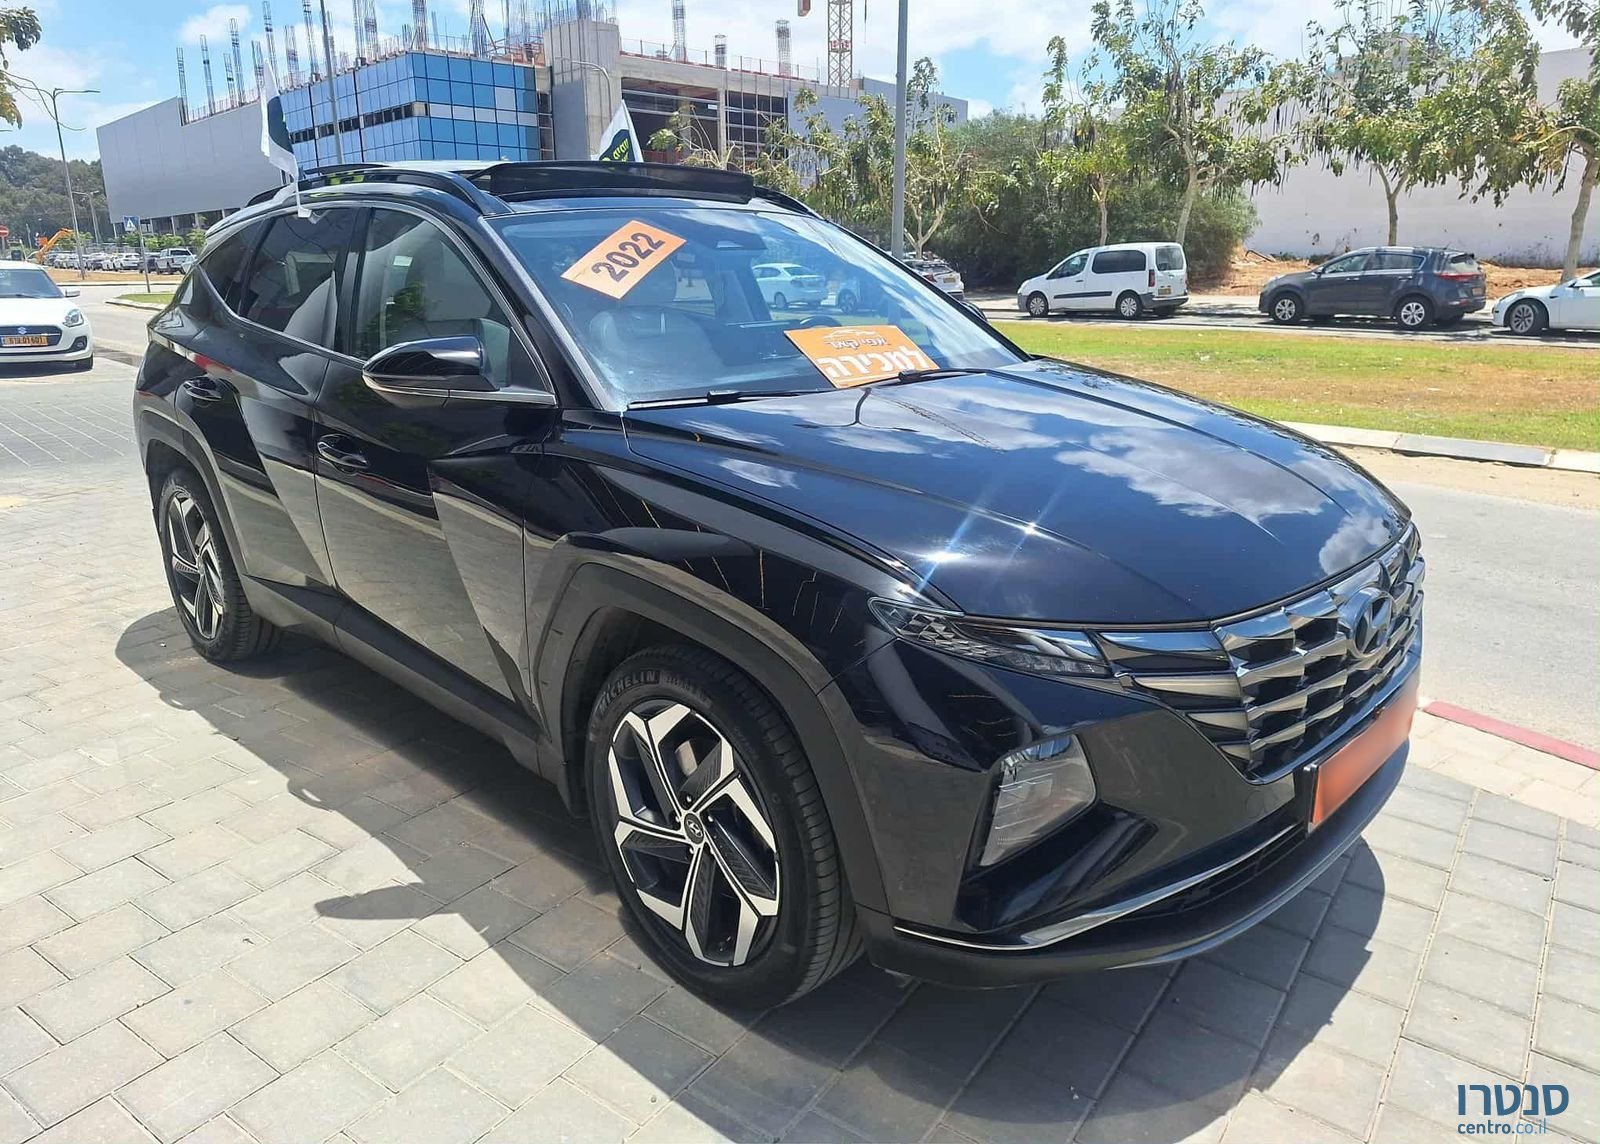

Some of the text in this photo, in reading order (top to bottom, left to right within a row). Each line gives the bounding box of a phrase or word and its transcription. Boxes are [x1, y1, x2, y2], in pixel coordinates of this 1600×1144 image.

[591, 232, 666, 283] 2022
[817, 345, 930, 378] למכירה
[599, 670, 656, 713] MICHELIN
